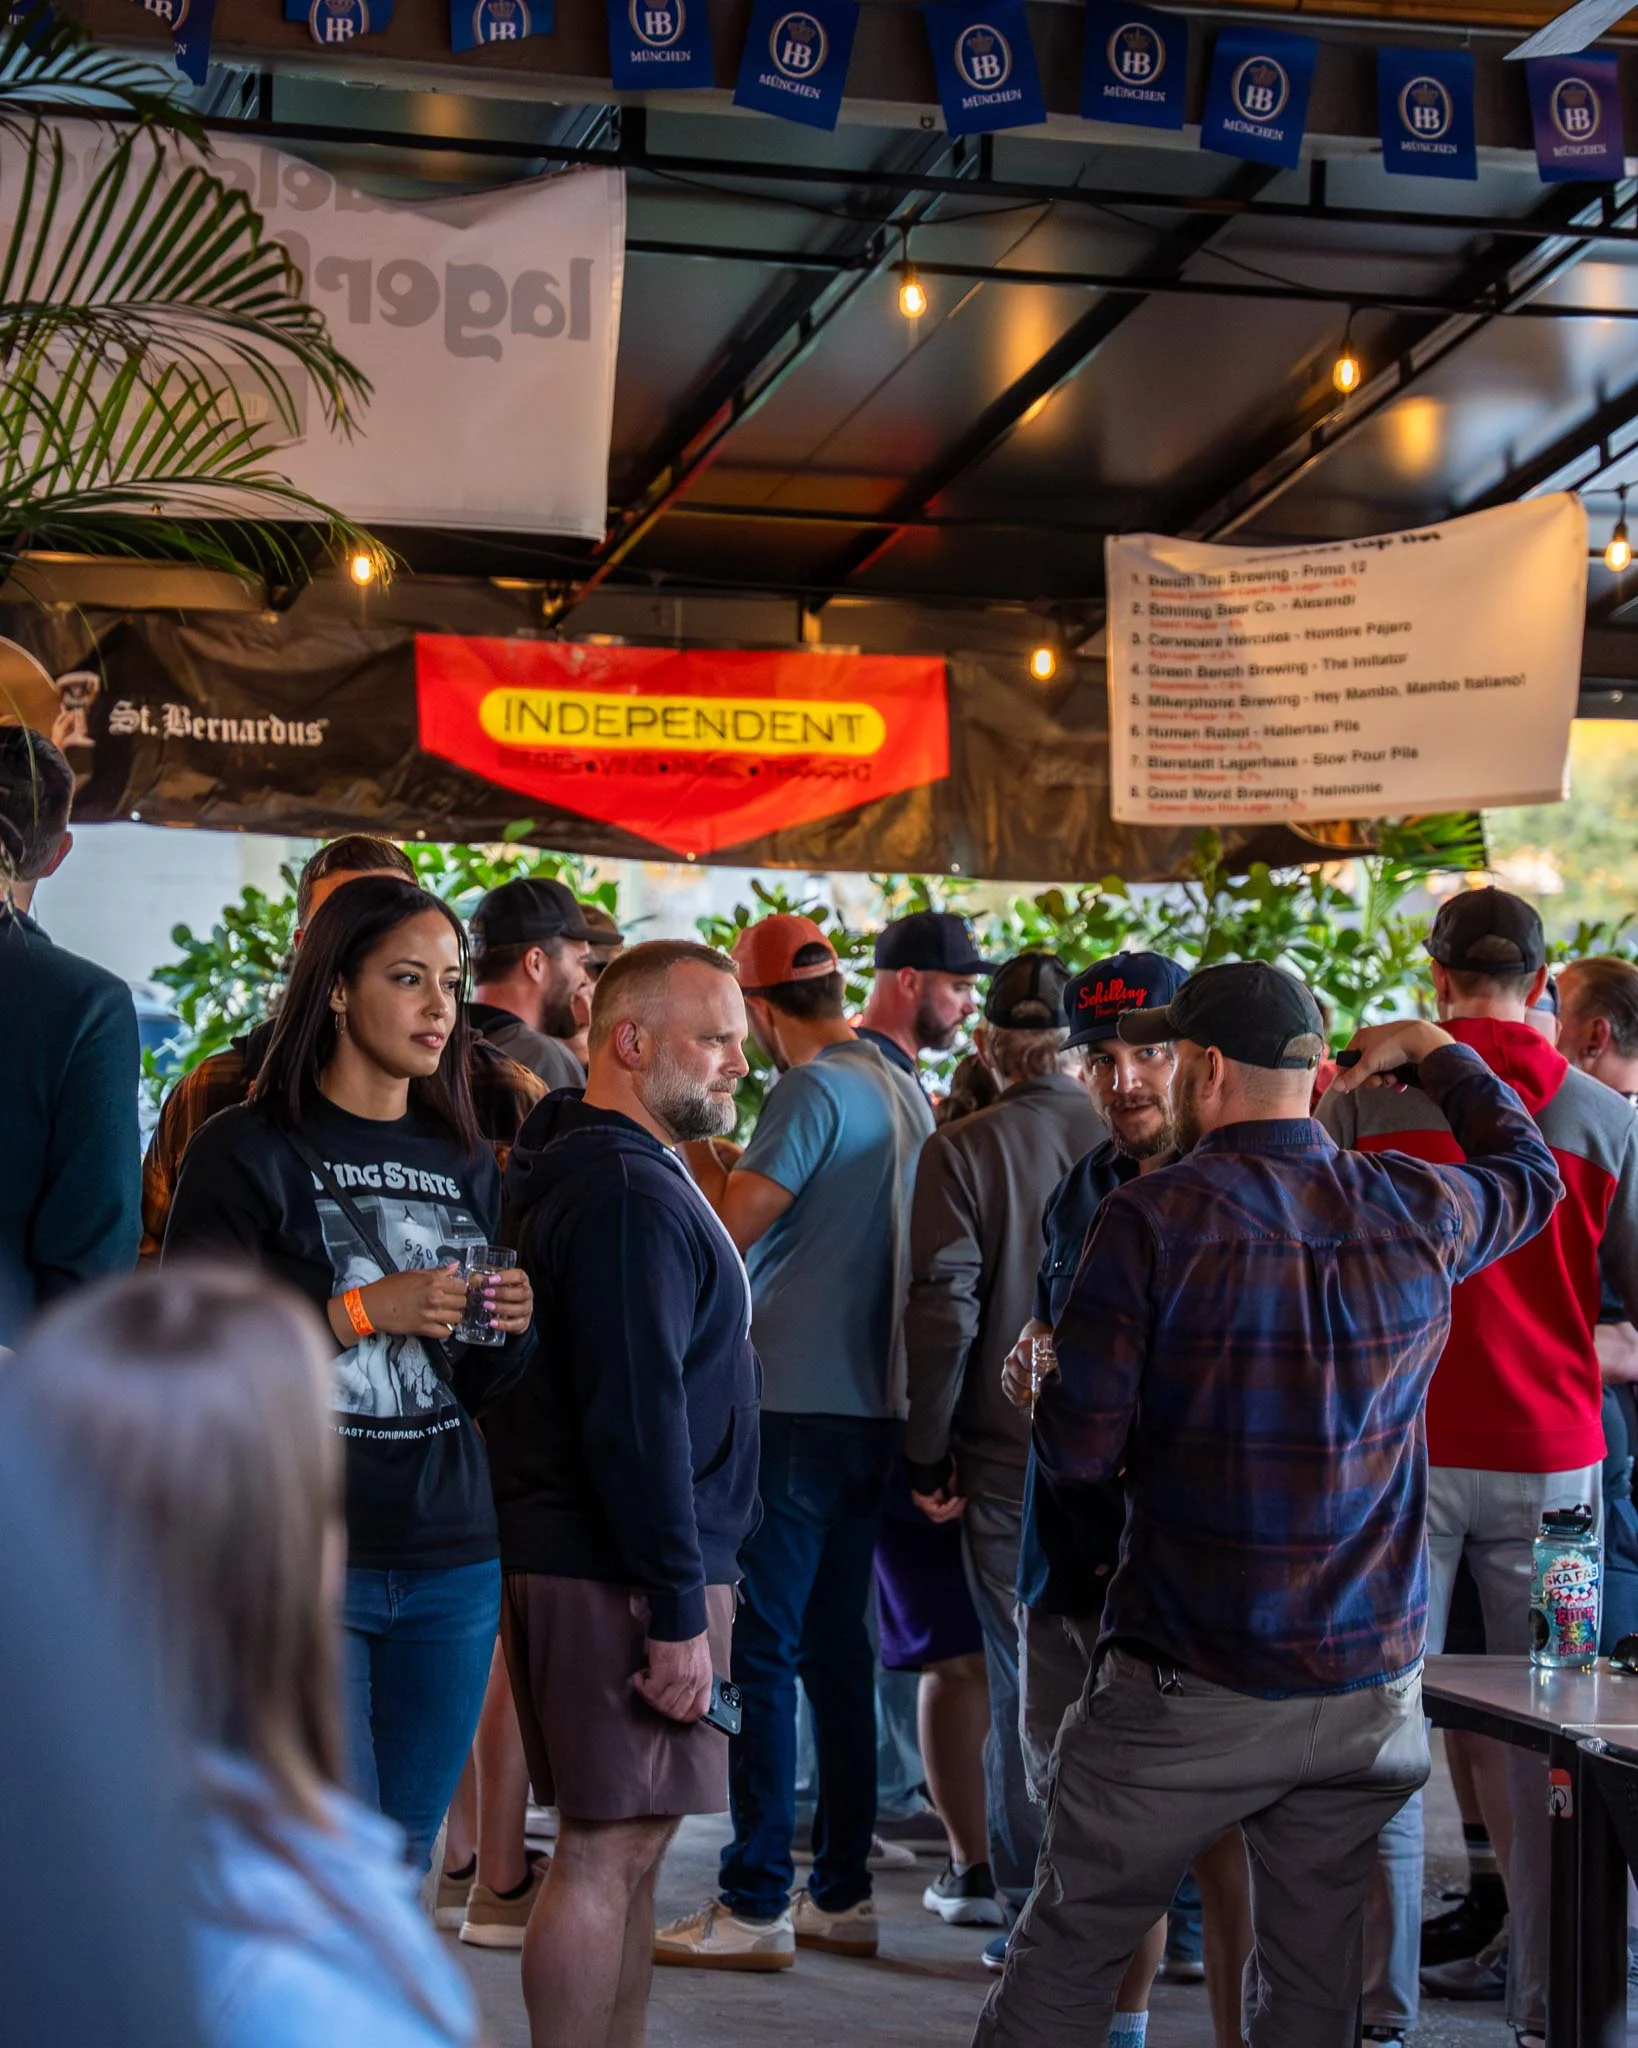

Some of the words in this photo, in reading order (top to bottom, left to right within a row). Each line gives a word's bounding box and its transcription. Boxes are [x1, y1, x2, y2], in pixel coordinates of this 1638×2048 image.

[644, 11, 672, 35] HB
[630, 49, 691, 62] MÜNCHEN
[782, 40, 811, 68] HB
[1122, 51, 1151, 75] HB
[971, 53, 1000, 80] HB
[758, 73, 821, 99] MÜNCHEN
[1103, 84, 1166, 102] MÜNCHEN
[962, 88, 1022, 109] MÜNCHEN
[1244, 84, 1273, 112] HB
[1413, 106, 1440, 129] HB
[1564, 107, 1590, 131] HB
[1223, 118, 1284, 141] MÜNCHEN
[1401, 140, 1457, 154] MÜNCHEN
[1553, 143, 1607, 157] MÜNCHEN
[1229, 568, 1290, 585] Brewing
[1249, 661, 1308, 677] Brewing
[1322, 656, 1349, 671] The
[1240, 694, 1300, 708] Brewing
[108, 700, 158, 736] St.
[161, 703, 326, 747] Bernardus
[503, 697, 866, 744] INDEPENDENT
[1237, 786, 1298, 801] Brewing
[1078, 977, 1148, 1010] Schilling
[338, 1426, 364, 1438] EAST
